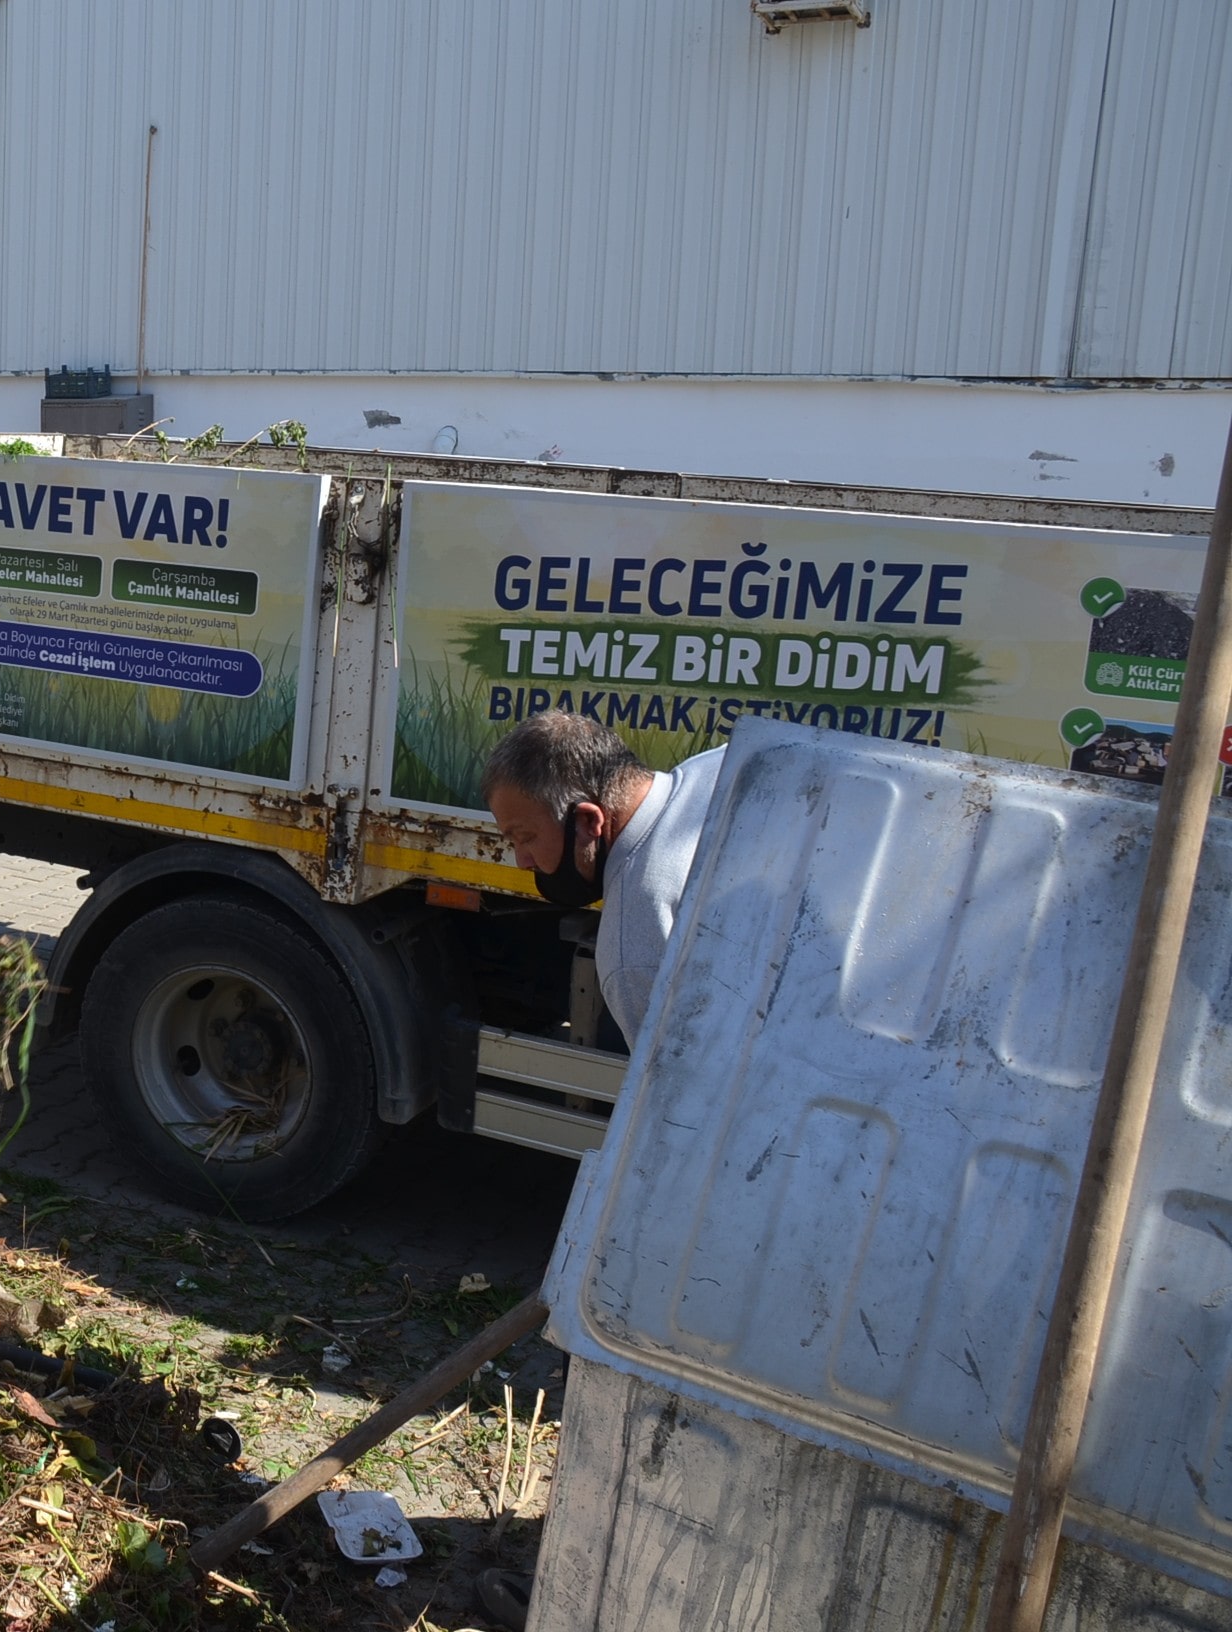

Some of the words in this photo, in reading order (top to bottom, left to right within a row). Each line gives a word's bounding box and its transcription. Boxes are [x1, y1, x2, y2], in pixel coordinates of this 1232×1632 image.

[113, 490, 230, 549] VAR!
[56, 558, 79, 573] Salı
[152, 567, 216, 587] Çarşamba
[25, 569, 83, 588] Mahallesi
[128, 580, 174, 598] Çamlık
[175, 585, 240, 605] Mahallesi
[9, 607, 35, 620] olarak
[36, 610, 47, 620] 29
[48, 611, 68, 623] Mart
[70, 613, 108, 628] Pazartesi
[110, 618, 133, 632] günü
[135, 620, 195, 638] başlayacaktır.
[23, 595, 46, 608] Efeler
[48, 601, 57, 609] ve
[59, 599, 87, 614] Çamlık
[89, 603, 165, 622] mahallelerimizde
[167, 612, 188, 626] pilot
[190, 615, 236, 631] uygulama
[11, 631, 65, 651] Boyunca
[68, 637, 101, 653] Farklı
[103, 642, 164, 661] Günlerde
[168, 650, 243, 672] Çıkarılması
[39, 649, 76, 666] Cezai
[77, 650, 116, 672] İşlem
[119, 660, 223, 686] Uygulanacaktır.
[1128, 664, 1153, 678] Kül
[1126, 677, 1180, 693] Atıkları
